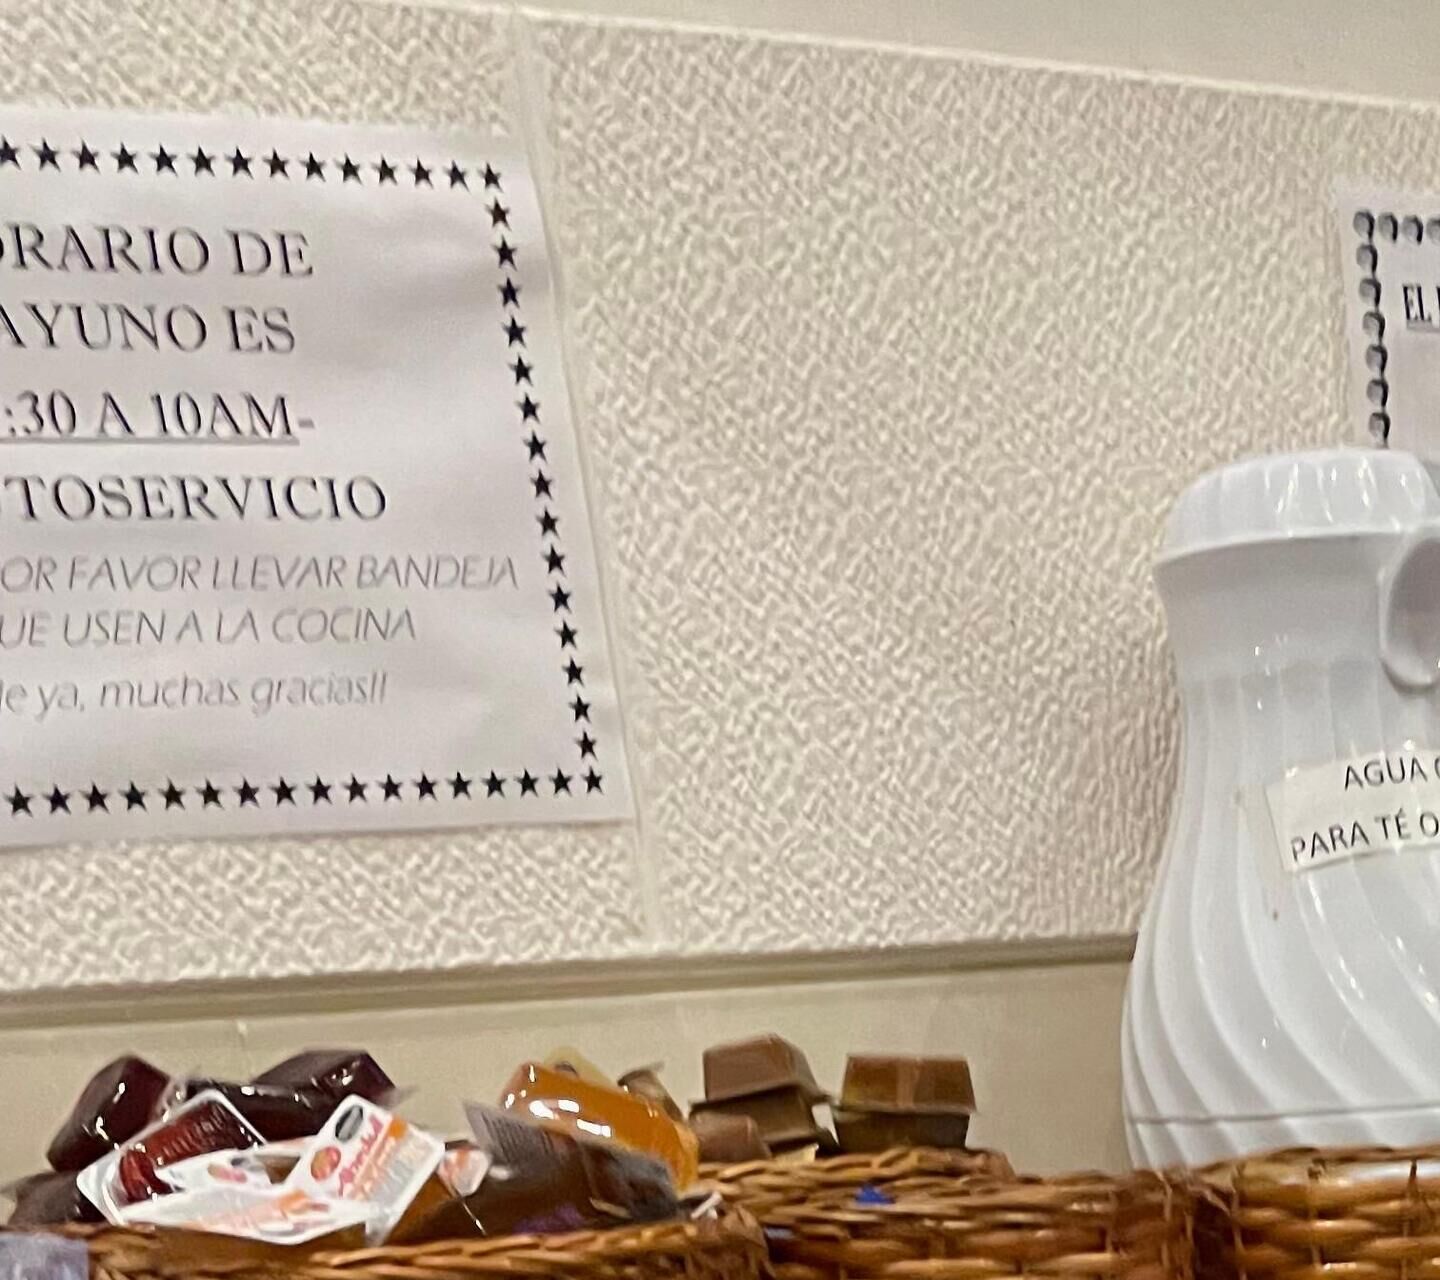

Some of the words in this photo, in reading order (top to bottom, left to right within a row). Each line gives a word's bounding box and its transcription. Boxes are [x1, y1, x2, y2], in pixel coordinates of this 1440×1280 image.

[224, 227, 314, 278] DE
[1403, 284, 1432, 322] EL
[224, 303, 296, 354] ES
[99, 390, 135, 437] A
[68, 555, 201, 593] FAVOR
[211, 555, 348, 592] LLEVAR
[356, 555, 520, 592] BANDEJA
[63, 608, 166, 647] USEN
[175, 607, 203, 645] A
[216, 606, 260, 645] LA
[271, 606, 418, 645] COCINA
[99, 670, 241, 710] muchas
[250, 669, 388, 717] gracias!!
[1343, 756, 1428, 791] AGUA
[1290, 820, 1370, 862] PARA
[1374, 807, 1409, 842] TÉ
[1418, 810, 1440, 838] O
